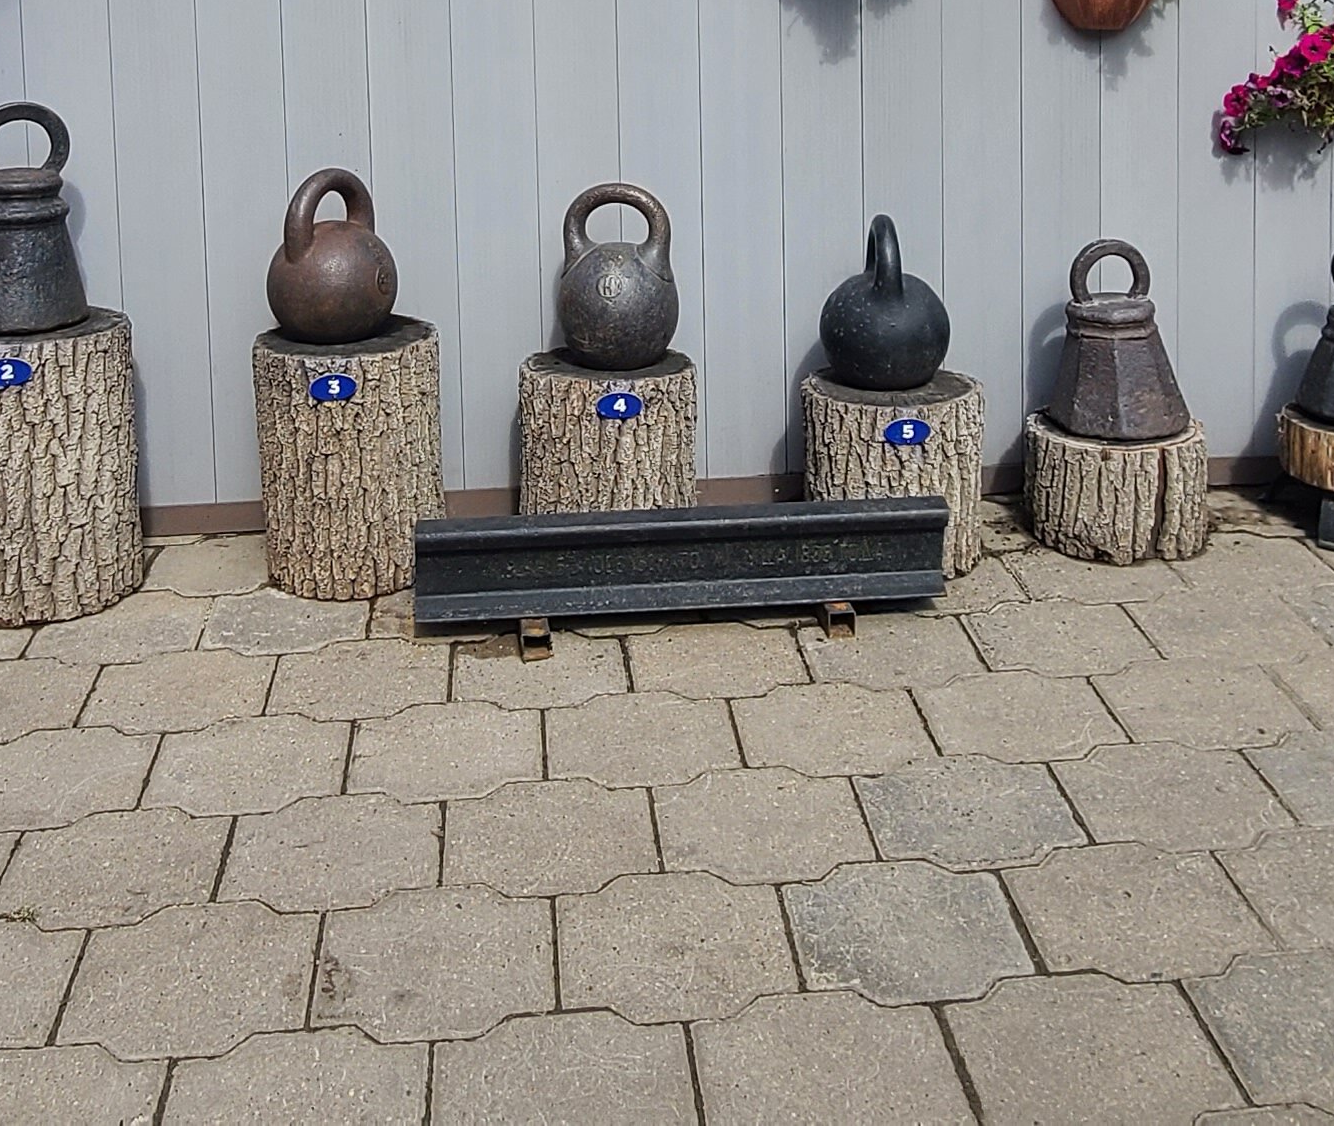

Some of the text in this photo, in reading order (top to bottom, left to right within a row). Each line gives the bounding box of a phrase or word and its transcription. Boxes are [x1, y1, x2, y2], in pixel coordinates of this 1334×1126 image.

[0, 364, 14, 380] 2
[328, 379, 340, 395] 3
[613, 398, 627, 413] 4
[902, 424, 915, 439] 5
